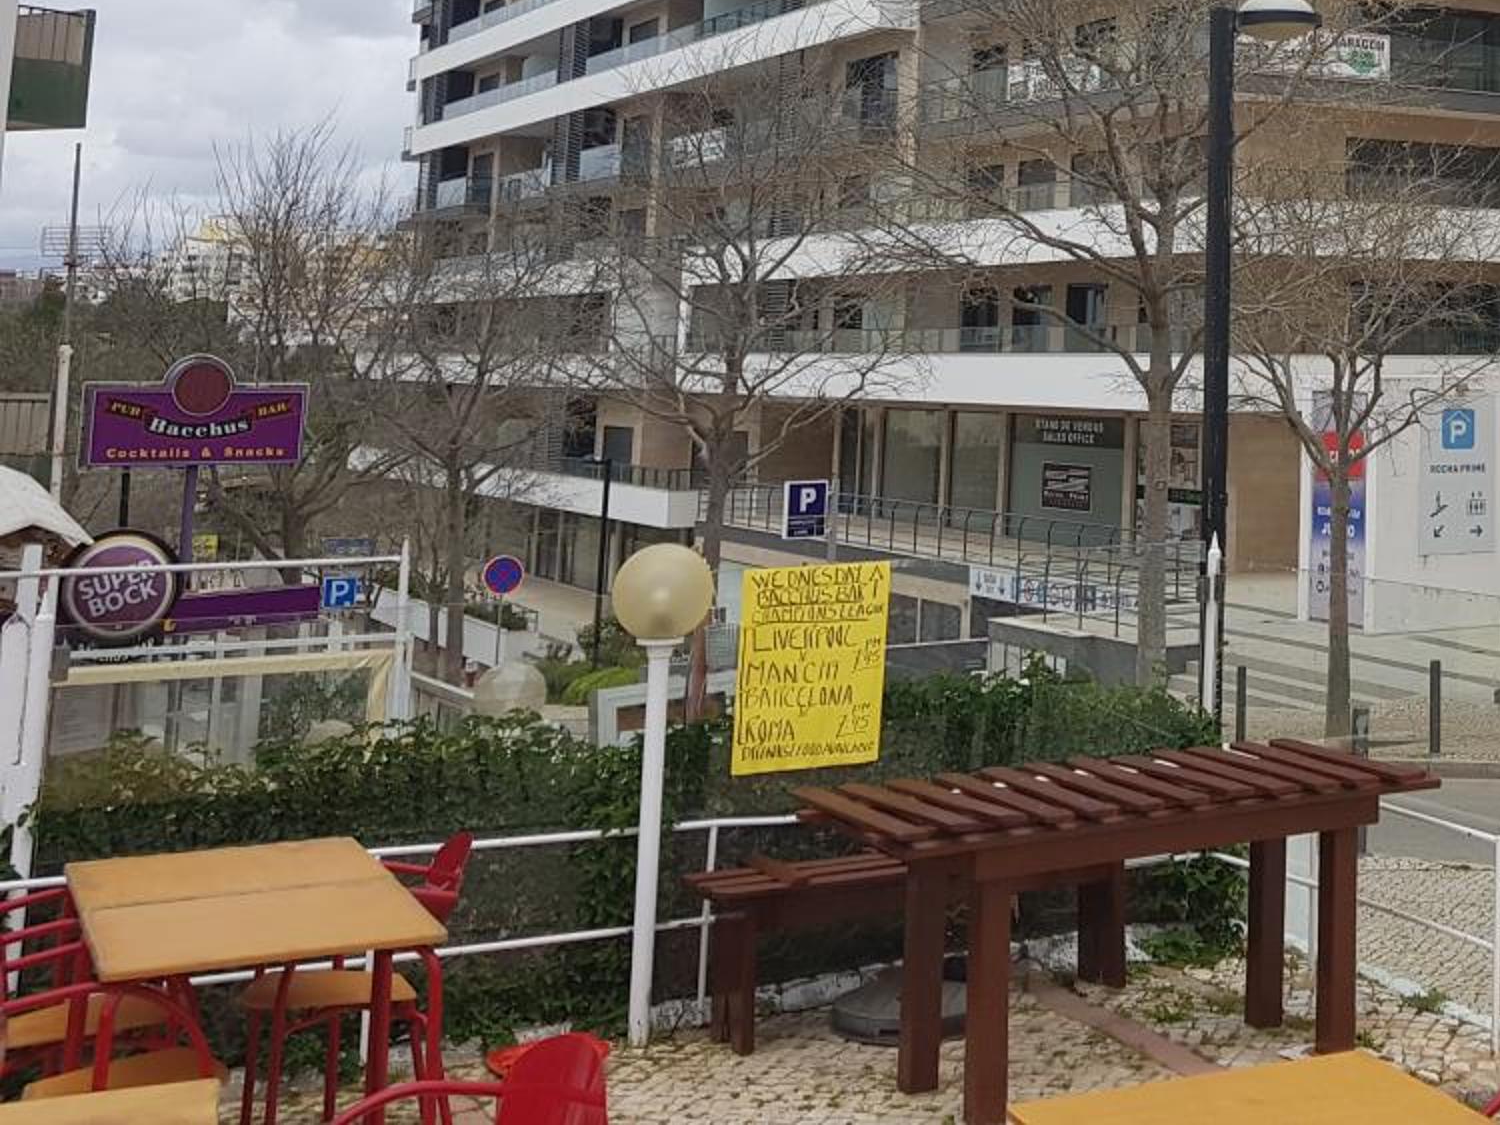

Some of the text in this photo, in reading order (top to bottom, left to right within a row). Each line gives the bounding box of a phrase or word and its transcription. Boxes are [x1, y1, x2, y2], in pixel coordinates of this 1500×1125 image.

[149, 417, 250, 438] Bacchus
[106, 447, 190, 458] Cocktails
[224, 446, 286, 457] Snacks
[800, 487, 816, 512] P
[88, 578, 158, 617] BOCK
